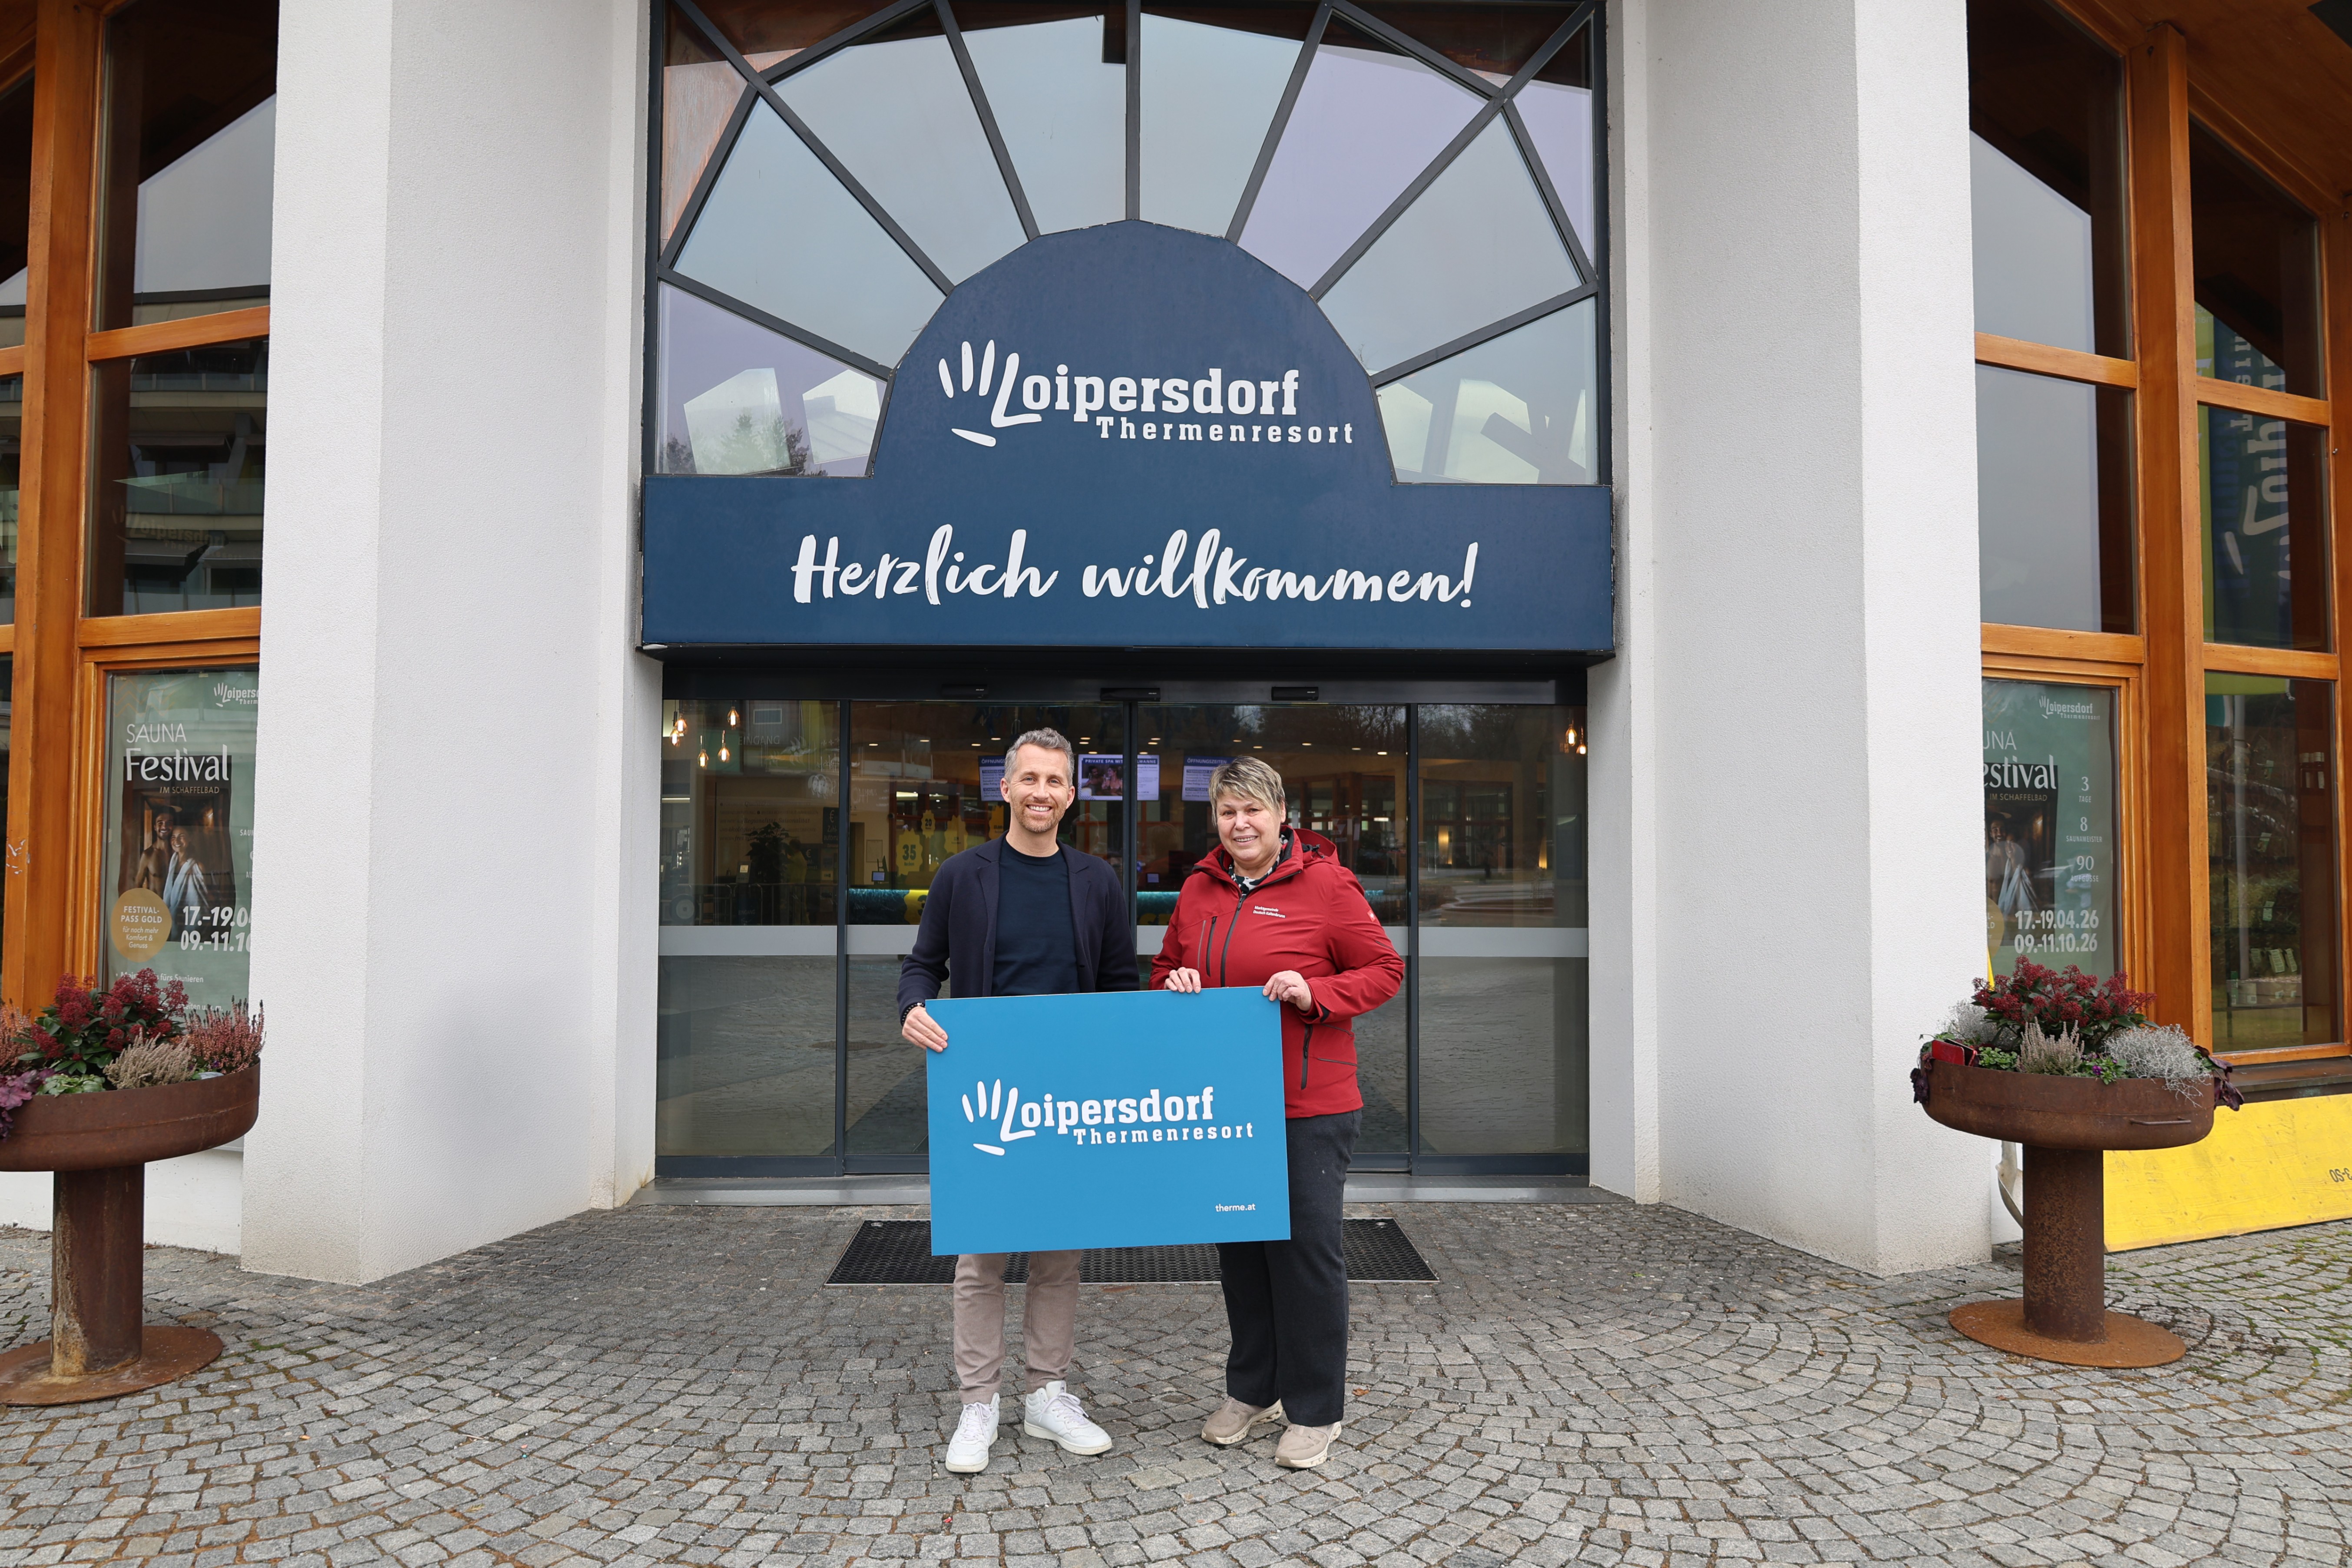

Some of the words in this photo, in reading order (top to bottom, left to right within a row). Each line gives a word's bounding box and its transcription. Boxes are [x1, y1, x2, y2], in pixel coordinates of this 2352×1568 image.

[991, 353, 1299, 427] Loipersdorf
[1097, 417, 1352, 443] Thermenresort
[791, 524, 1059, 605] Herzlich
[1082, 529, 1478, 609] willkommen!
[222, 685, 259, 703] Loipers
[2046, 698, 2093, 715] Loipersdorf
[126, 723, 187, 743] SAUNA
[126, 744, 229, 781] Festival
[2081, 776, 2089, 791] 3
[925, 818, 932, 826] 20
[2080, 817, 2088, 831] 8
[902, 844, 916, 860] 35
[2076, 856, 2094, 871] 90
[2070, 873, 2099, 883] AUFGÜSSE
[123, 906, 160, 914] FESTIVAL-
[182, 906, 251, 927] 17.-19.0
[120, 915, 139, 923] PASS
[141, 915, 162, 923] GOLD
[2015, 910, 2099, 930] 17.-19.04.26
[2014, 933, 2098, 954] 09.-11.10.26
[160, 973, 173, 981] fürs
[1000, 1086, 1214, 1142] Loipersdorf
[1073, 1123, 1253, 1145] Thermenresort
[1215, 1204, 1256, 1212] therme.at
